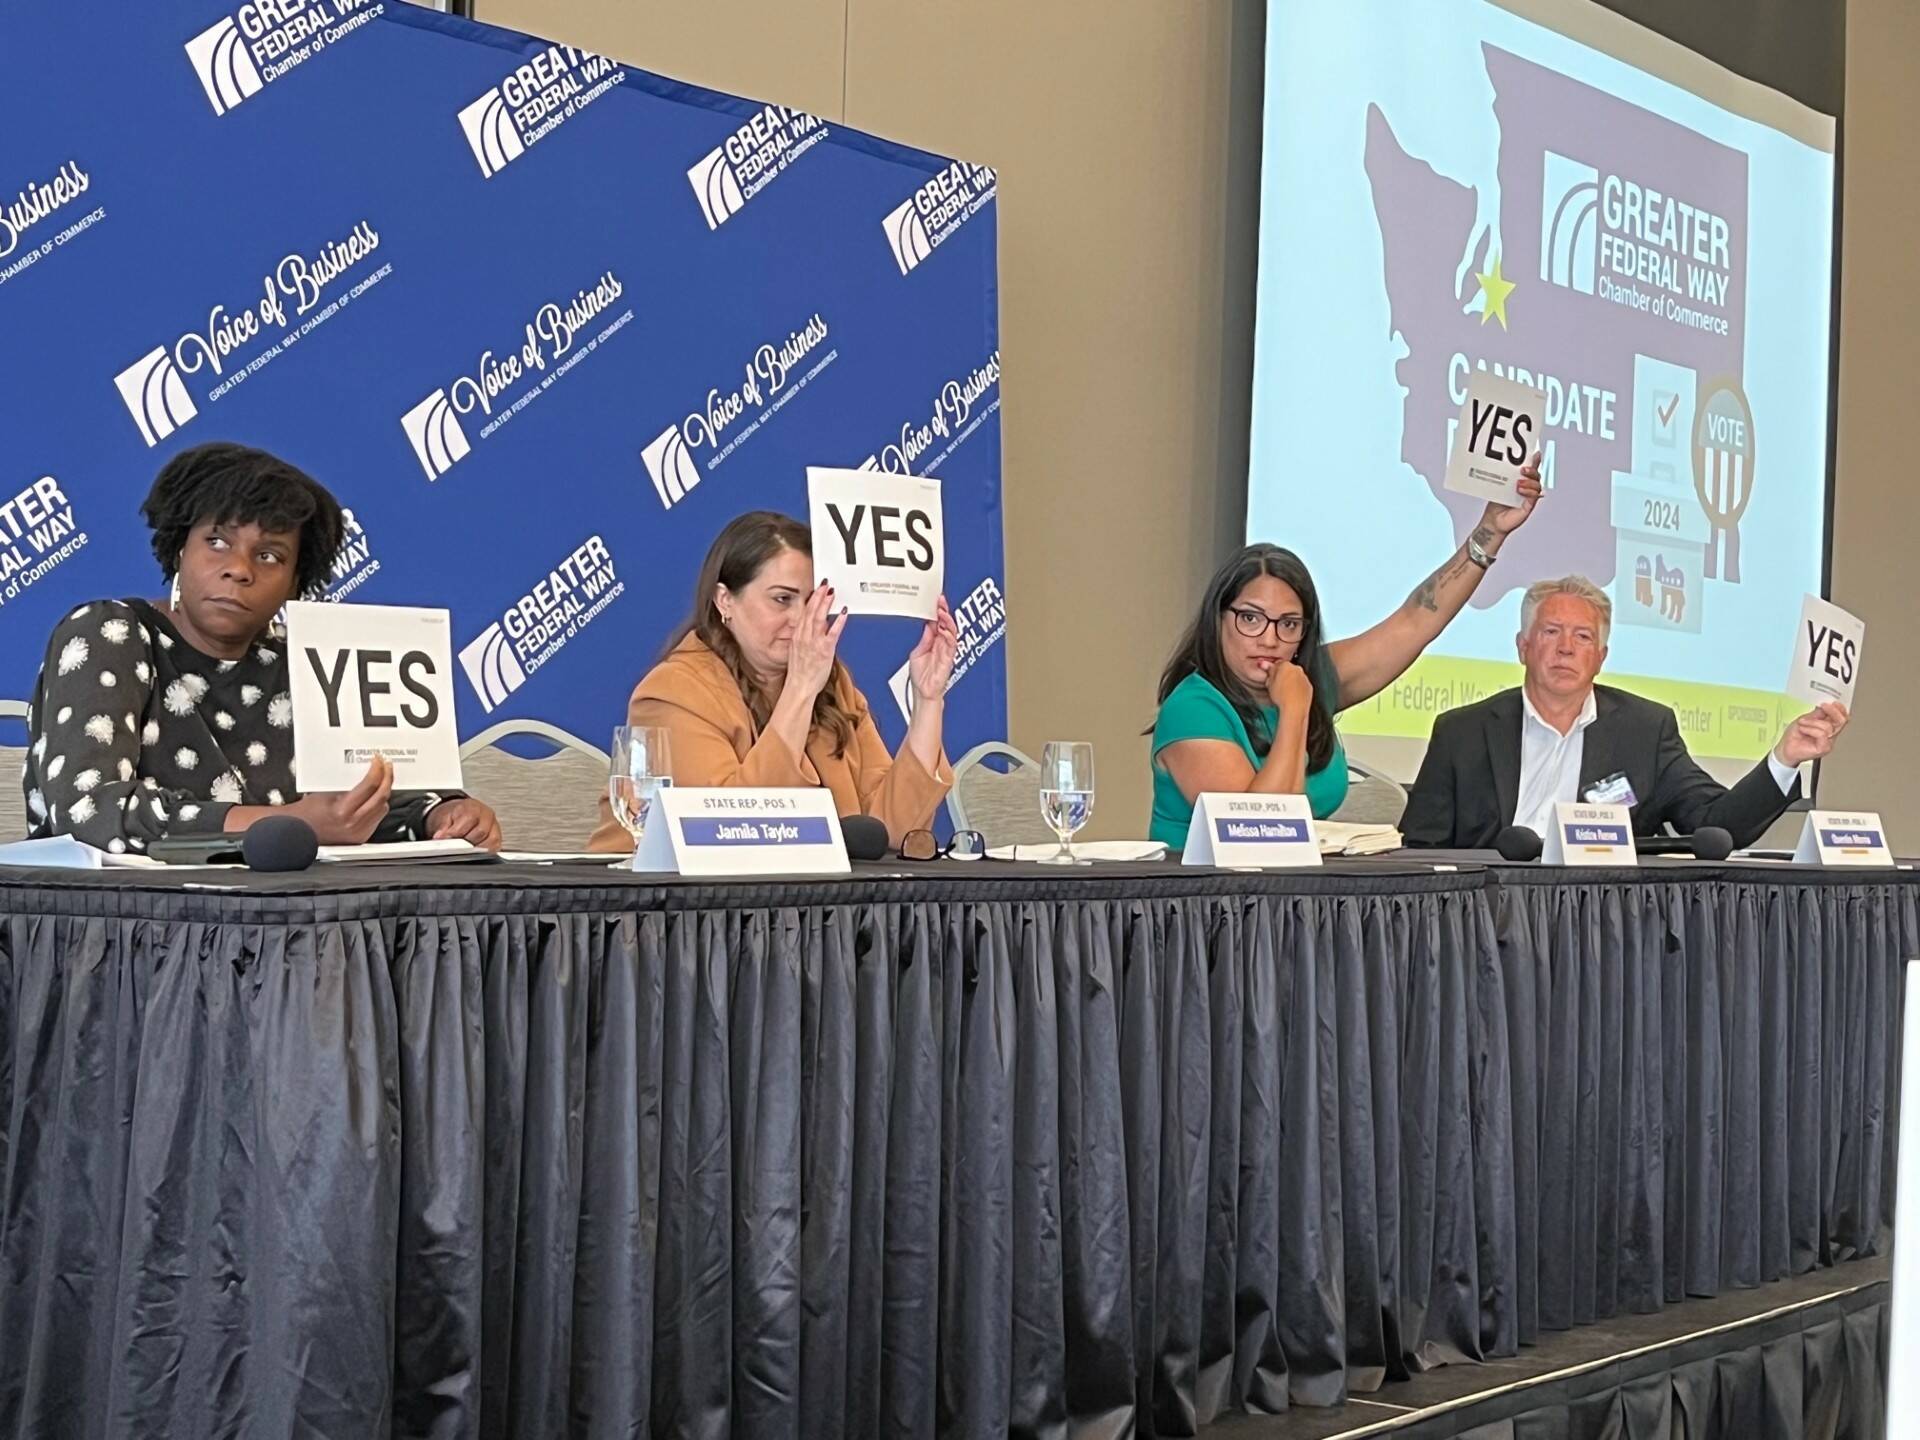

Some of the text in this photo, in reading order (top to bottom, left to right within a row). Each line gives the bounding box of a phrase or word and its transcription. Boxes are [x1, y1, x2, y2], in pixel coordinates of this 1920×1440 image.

[238, 0, 321, 39] GRE
[251, 3, 335, 66] FEDERAL
[262, 45, 312, 82] Chamber
[312, 34, 325, 52] of
[324, 3, 384, 43] Commerce
[513, 73, 583, 131] FEDERAL
[523, 71, 625, 147] Chamber of Commerce
[735, 129, 793, 187] FEDERAL
[743, 127, 829, 200] Chamber of Commerce
[915, 160, 983, 215] GREAT
[41, 240, 54, 255] OF
[54, 206, 106, 245] COMMERCE
[923, 166, 997, 236] FEDERAL WA
[961, 207, 970, 221] of
[1603, 174, 1730, 269] GREATER
[175, 220, 379, 375] Voice of Business
[1600, 232, 1729, 307] FEDERAL WAY
[208, 262, 394, 401] GREATER FEDERAL WAY CHAMBER OF COMMERCE
[1599, 275, 1728, 336] Chamber of Commerce
[451, 271, 622, 415] Voice of Business
[480, 309, 635, 439] GREATER FEDERAL WAY CHAMBER OF COMMERCE
[683, 313, 828, 448] Voice of Business
[1448, 352, 1616, 441] CDATE
[881, 422, 932, 476] Voice
[932, 398, 949, 437] of
[1468, 398, 1532, 466] YES
[1707, 412, 1744, 447] VOTE
[0, 476, 68, 545] TER
[26, 505, 76, 554] WAY
[825, 503, 934, 571] YES
[1644, 499, 1680, 532] 2024
[5, 532, 88, 598] of Commerce
[332, 535, 370, 579] WAY
[503, 535, 610, 639] GREATER
[514, 559, 616, 661] FEDERAL WAY
[525, 581, 625, 675] Chamber of Commerce
[954, 577, 1001, 640] ATER
[979, 599, 1006, 632] WAY
[1807, 619, 1856, 685] YES
[304, 647, 439, 729] YES
[1393, 676, 1454, 711] Federal
[703, 798, 736, 809] STATE
[790, 799, 797, 808] 1
[716, 822, 799, 843] Jamila Taylor
[1227, 823, 1298, 837] Melissa Hamilton
